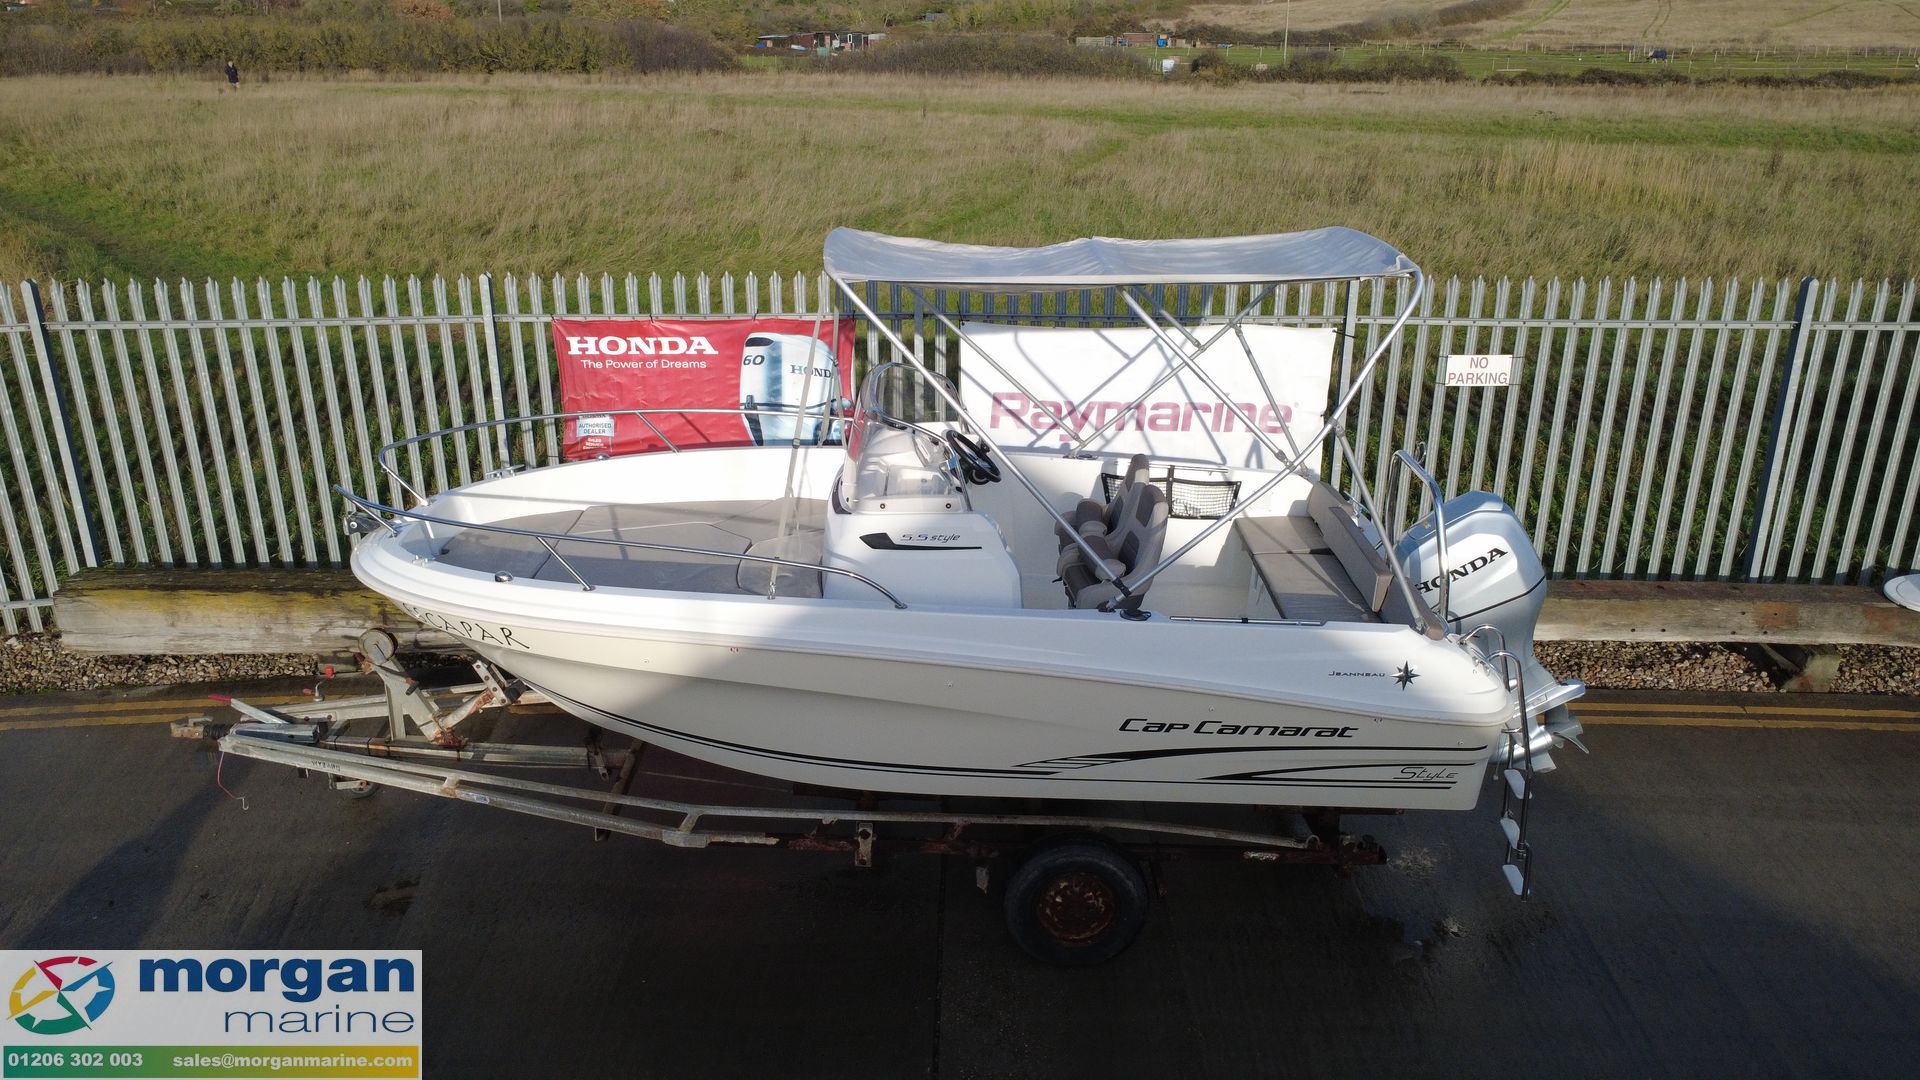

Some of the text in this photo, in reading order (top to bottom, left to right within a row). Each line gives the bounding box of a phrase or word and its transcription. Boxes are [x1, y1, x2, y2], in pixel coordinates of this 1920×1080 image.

[566, 336, 719, 355] HONDA
[581, 359, 707, 369] The Power of Dreams
[743, 354, 765, 366] 60
[1469, 356, 1488, 369] NO
[1447, 372, 1508, 385] PARKING
[990, 391, 1292, 442] Raymarine
[930, 533, 961, 544] style
[1193, 720, 1359, 738] Camarat
